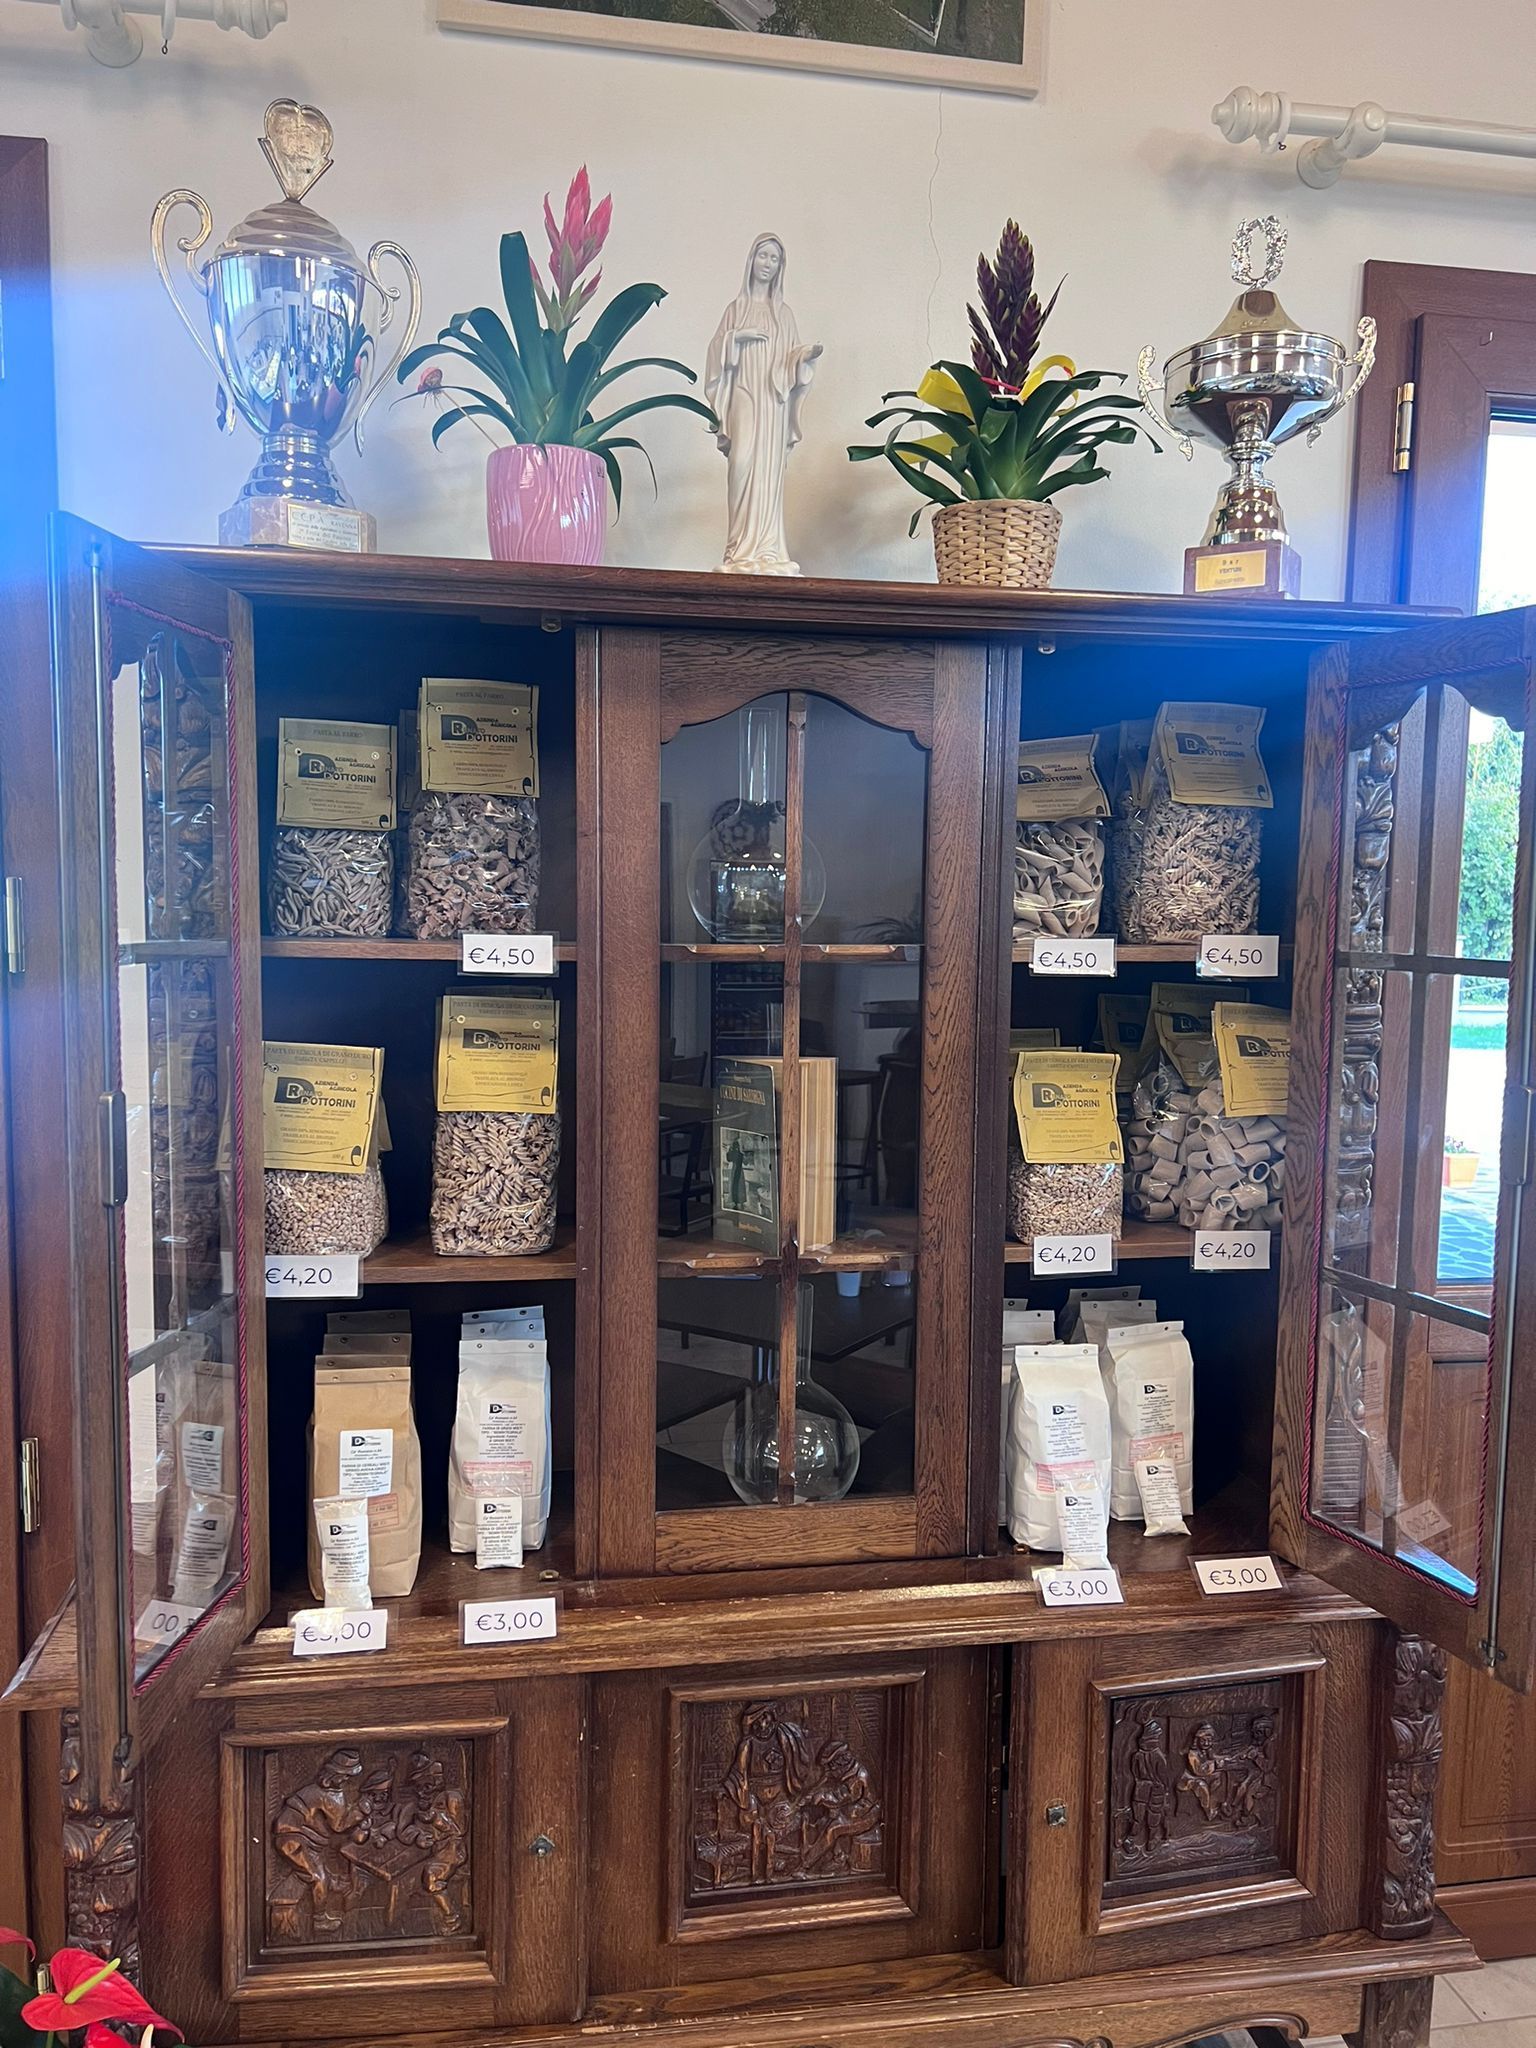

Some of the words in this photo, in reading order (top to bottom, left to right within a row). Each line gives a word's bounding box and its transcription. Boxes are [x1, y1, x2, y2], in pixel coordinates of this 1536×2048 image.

[468, 947, 535, 968] €4,50
[1038, 951, 1097, 970] €4,50
[1205, 947, 1263, 966] €4,50
[1038, 1246, 1096, 1264] €4,20
[1200, 1241, 1256, 1261] €4,20
[265, 1267, 332, 1287] €4,20
[1209, 1568, 1267, 1586] €3,00
[1047, 1579, 1108, 1599] €3,00
[475, 1611, 543, 1633] €3,00
